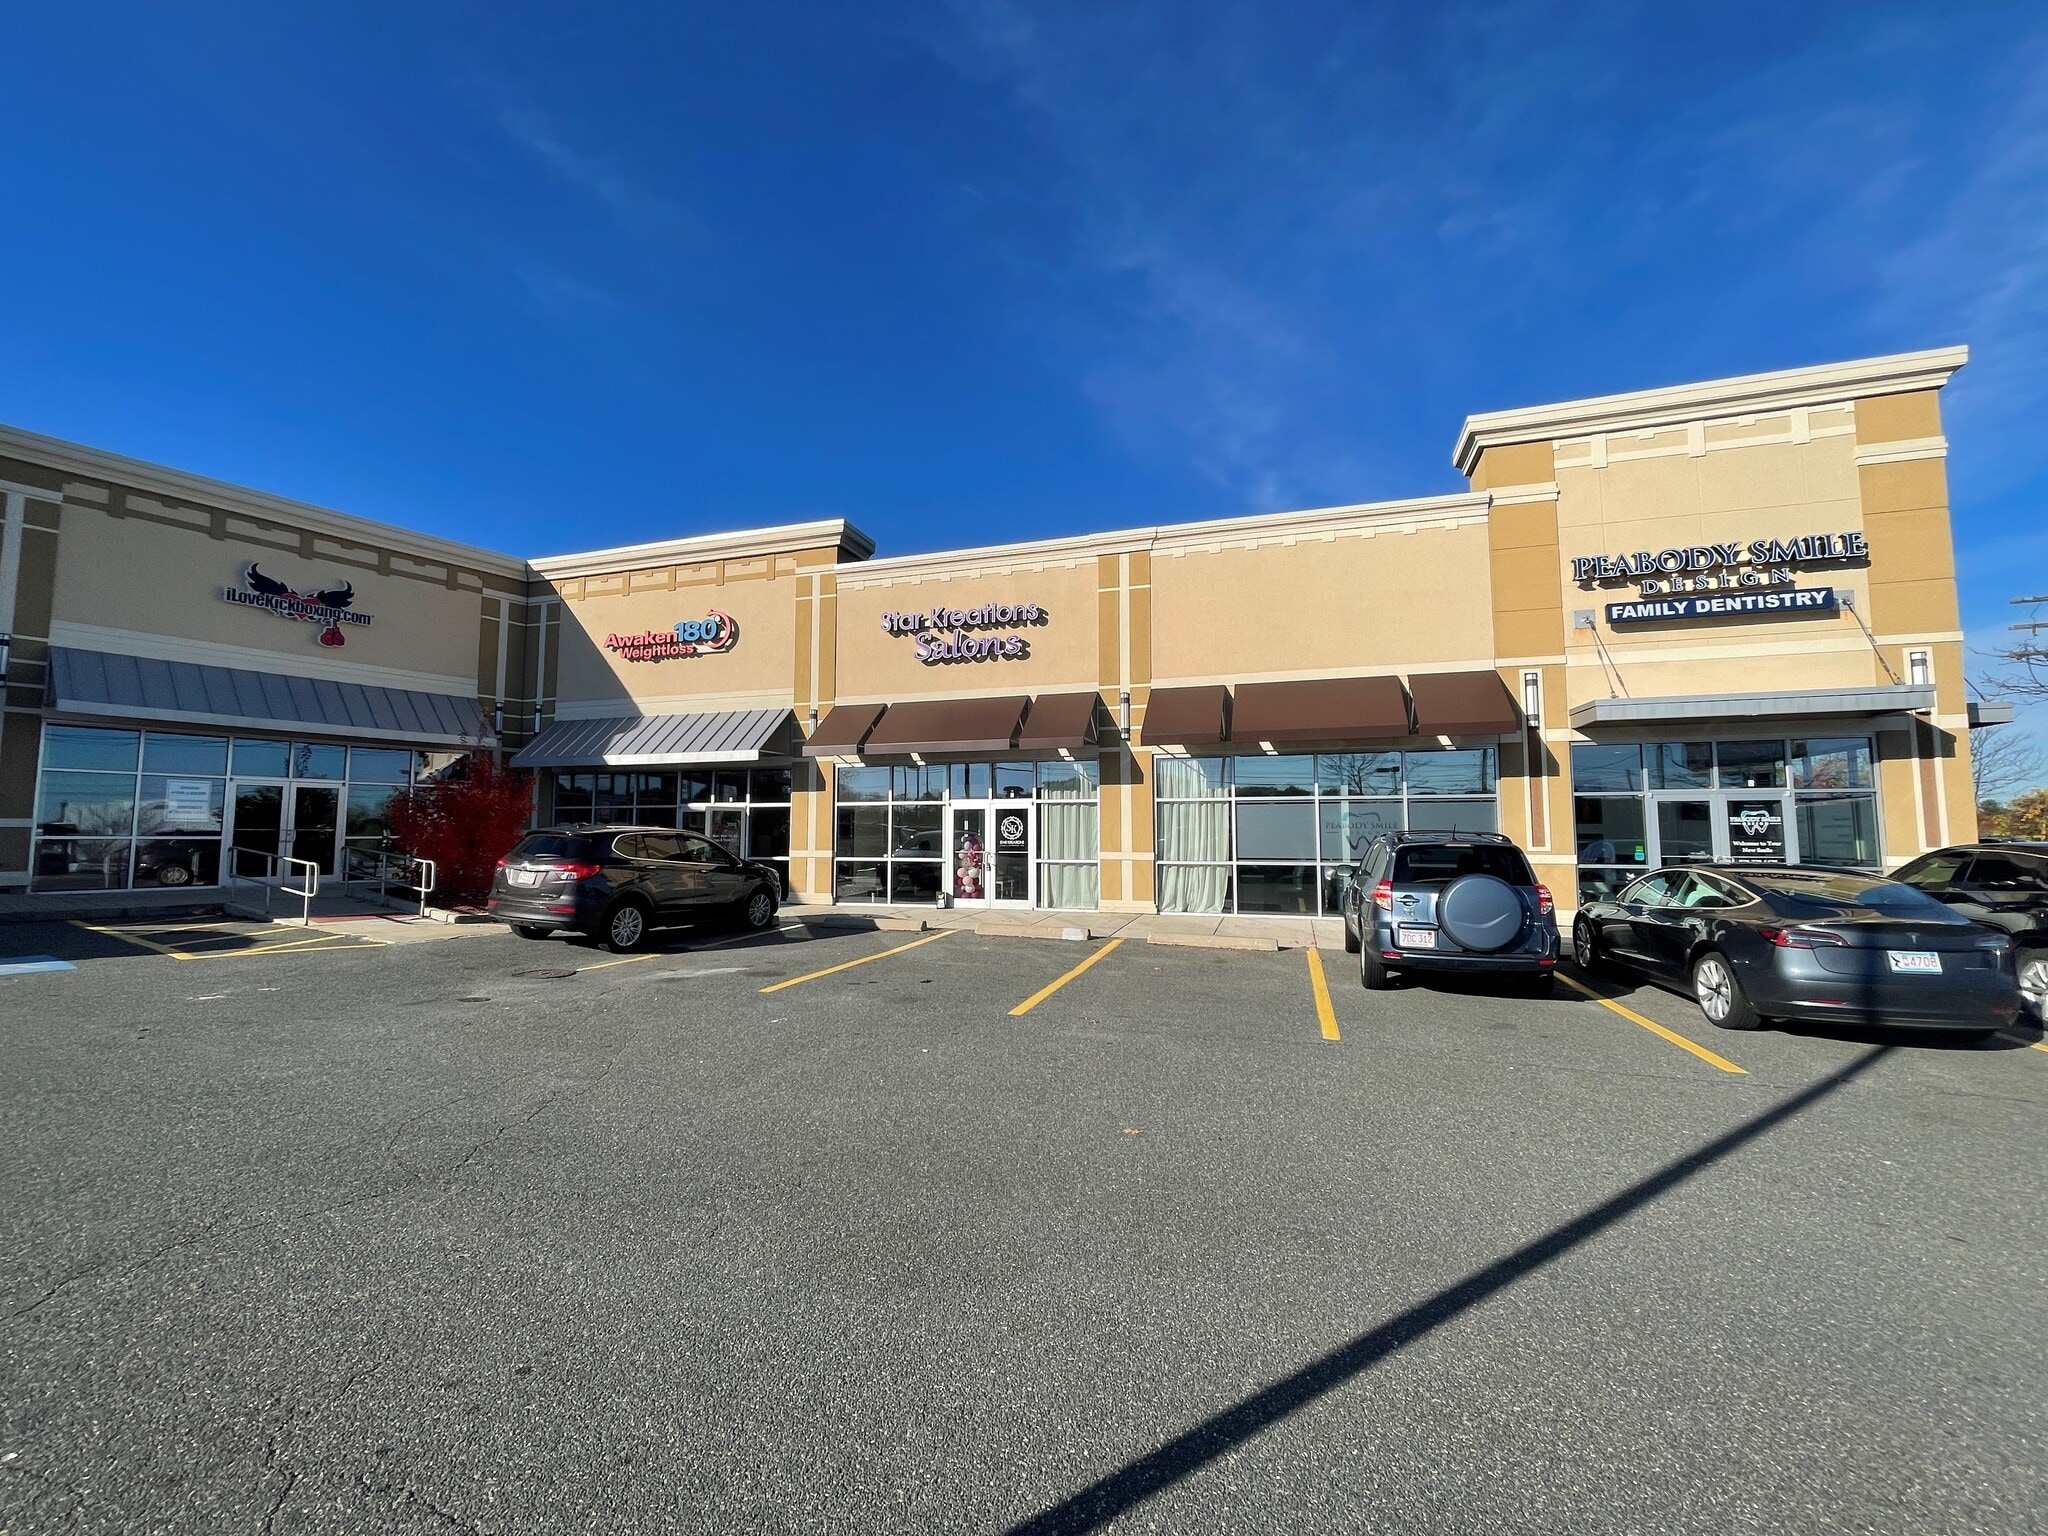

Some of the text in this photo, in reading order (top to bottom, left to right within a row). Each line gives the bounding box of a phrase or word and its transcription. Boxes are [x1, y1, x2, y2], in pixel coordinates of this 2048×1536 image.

[1572, 531, 1867, 581] PEABODY SMILE
[1641, 568, 1791, 595] DESIGN
[226, 586, 371, 625] iLoveKickboxing.com
[881, 602, 1040, 632] Star Kreations
[1611, 591, 1827, 619] FAMILY DENTISTRY
[619, 643, 695, 659] Weightloss
[914, 628, 1022, 661] Salons
[1370, 821, 1398, 829] SMILE
[1418, 934, 1433, 944] 312
